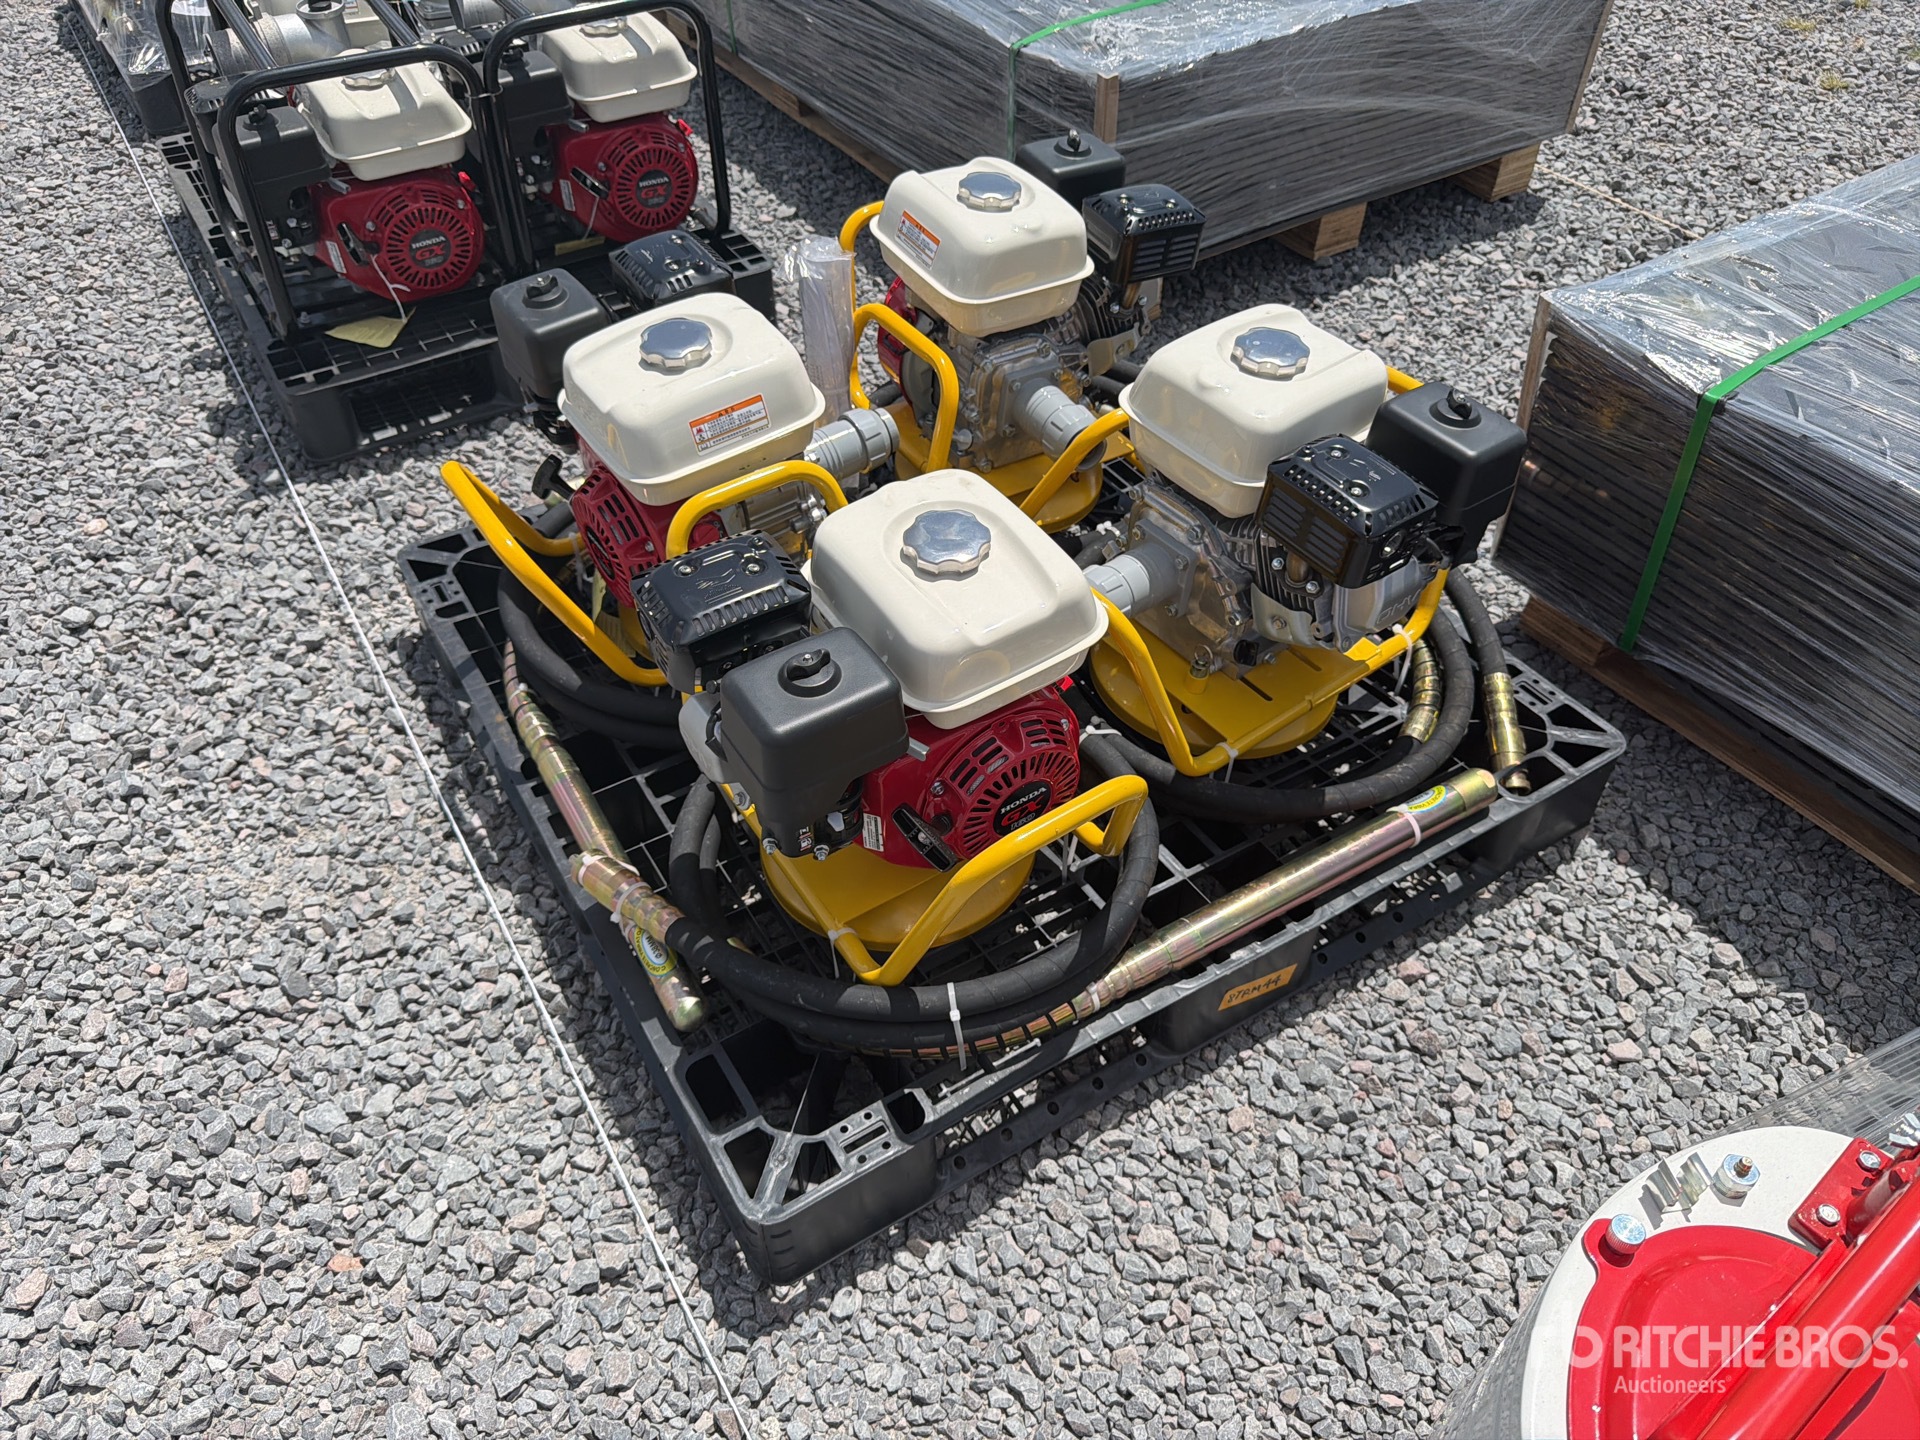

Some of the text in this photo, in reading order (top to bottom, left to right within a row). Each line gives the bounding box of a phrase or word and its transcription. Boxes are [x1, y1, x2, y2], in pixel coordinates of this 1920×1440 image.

[639, 176, 669, 188] HONDA
[411, 235, 446, 249] HONDA
[415, 243, 446, 260] GX
[1000, 786, 1048, 815] HONDA
[1001, 795, 1045, 827] GX
